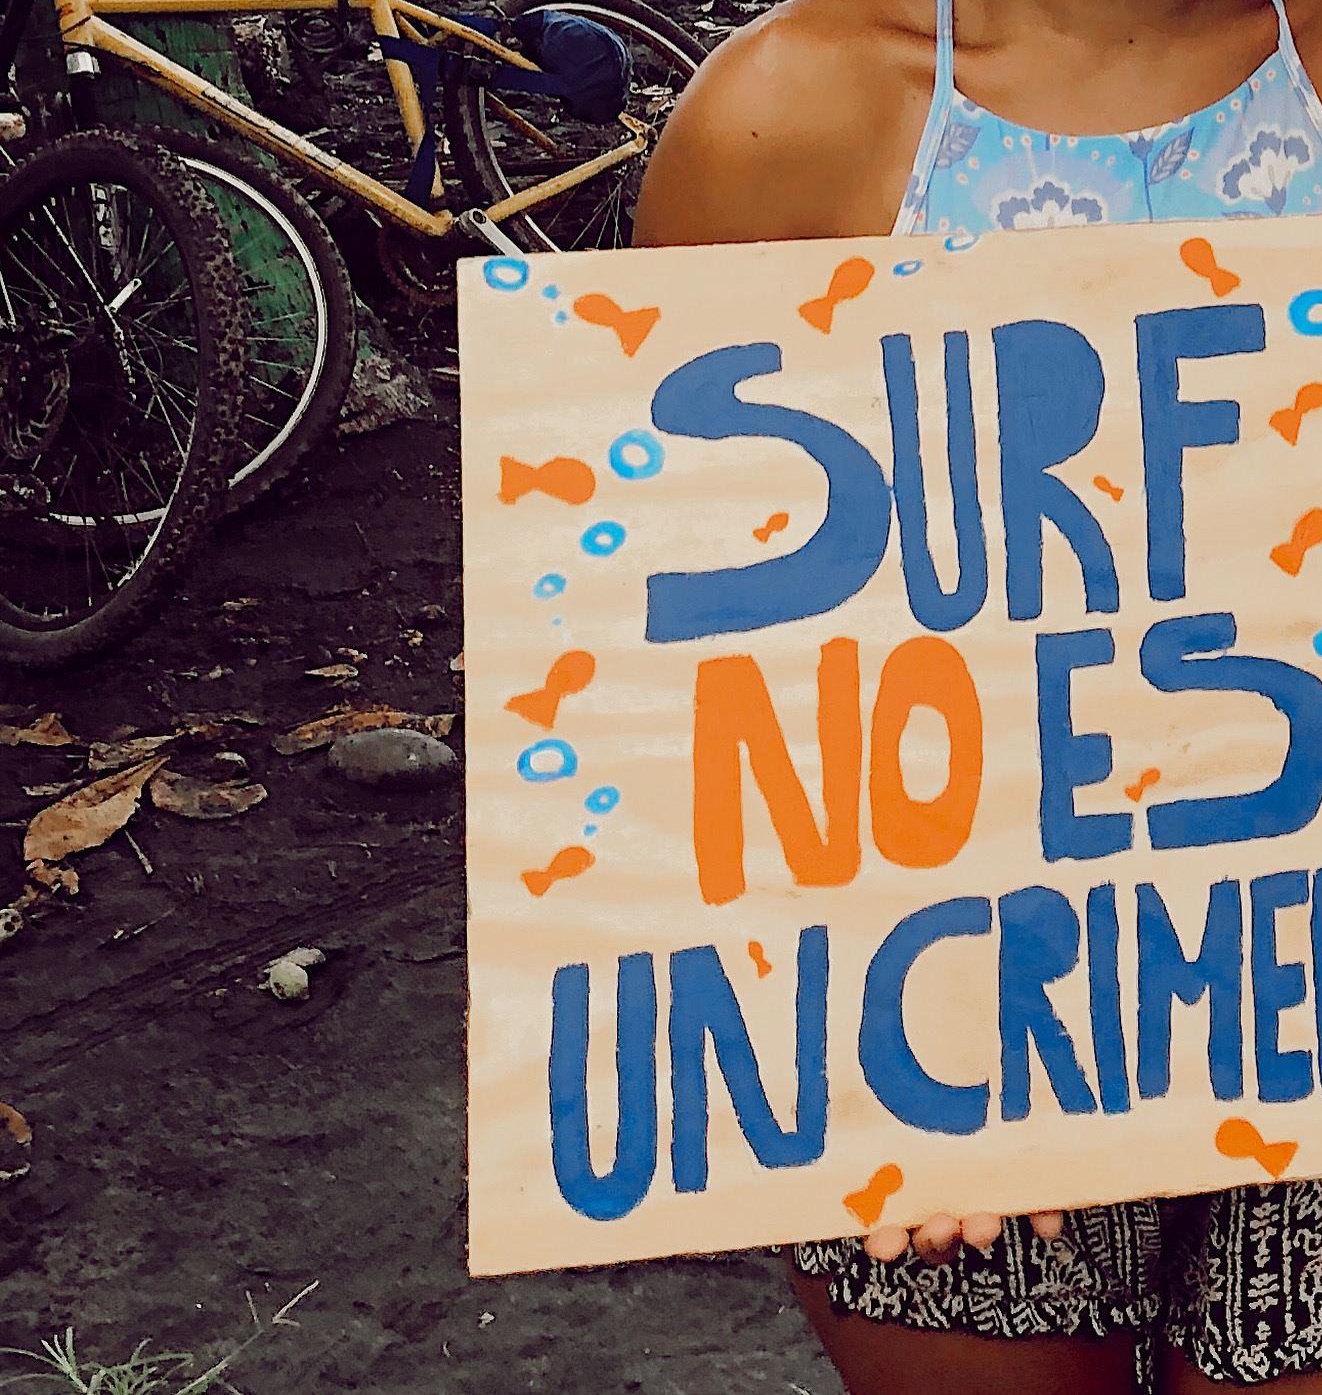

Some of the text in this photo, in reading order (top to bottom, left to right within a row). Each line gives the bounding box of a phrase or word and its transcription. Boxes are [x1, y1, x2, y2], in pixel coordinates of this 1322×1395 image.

[646, 303, 1267, 643] SURF
[692, 635, 984, 907] NO
[549, 926, 831, 1222] UN
